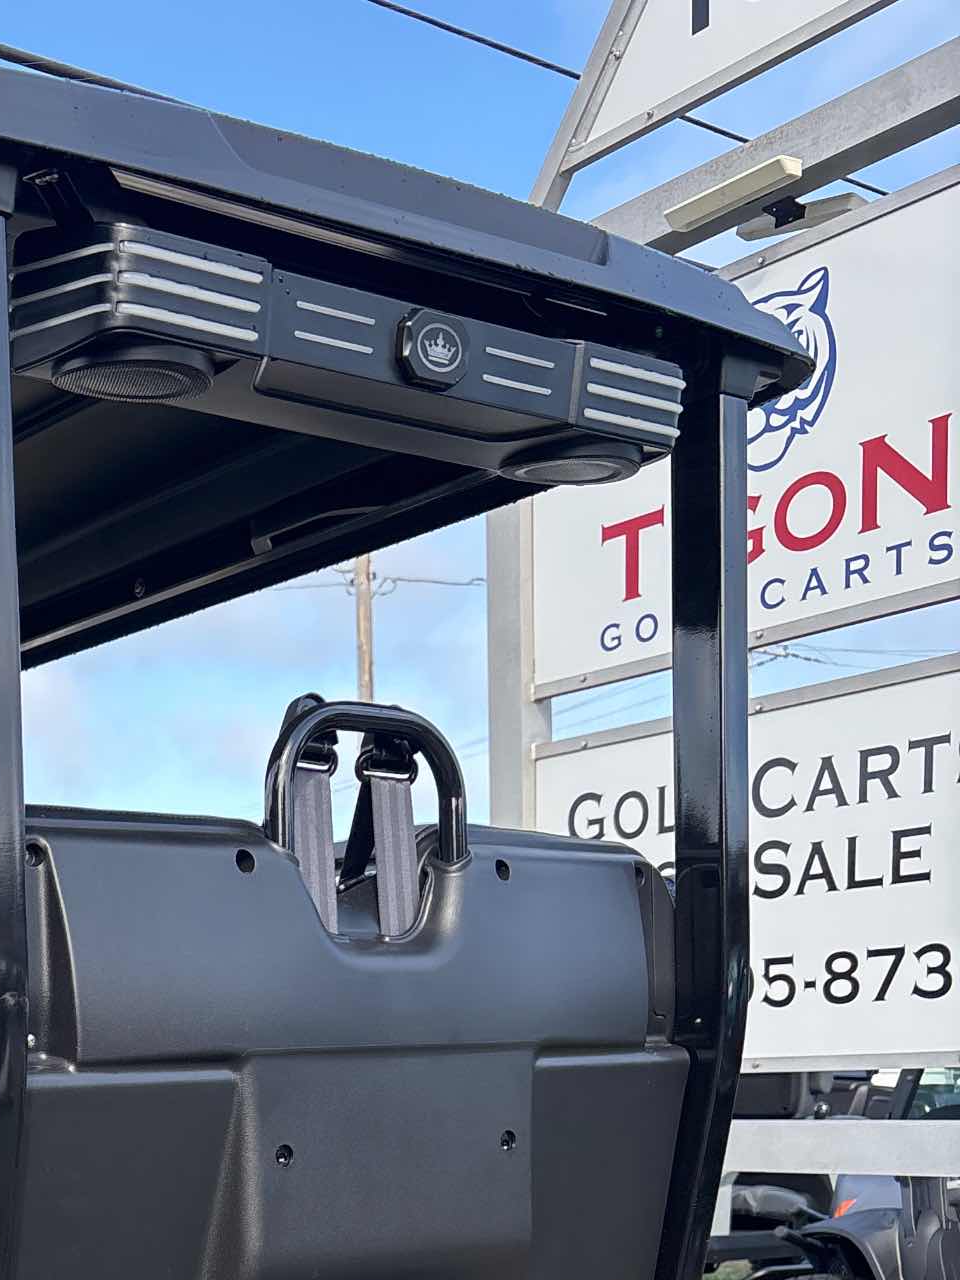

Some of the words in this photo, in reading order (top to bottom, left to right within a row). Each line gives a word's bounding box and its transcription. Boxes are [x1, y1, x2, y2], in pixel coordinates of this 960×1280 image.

[600, 413, 953, 602] TON
[759, 530, 954, 610] CARTS
[568, 785, 676, 840] GOL
[751, 731, 960, 818] CART
[752, 822, 933, 900] SALE
